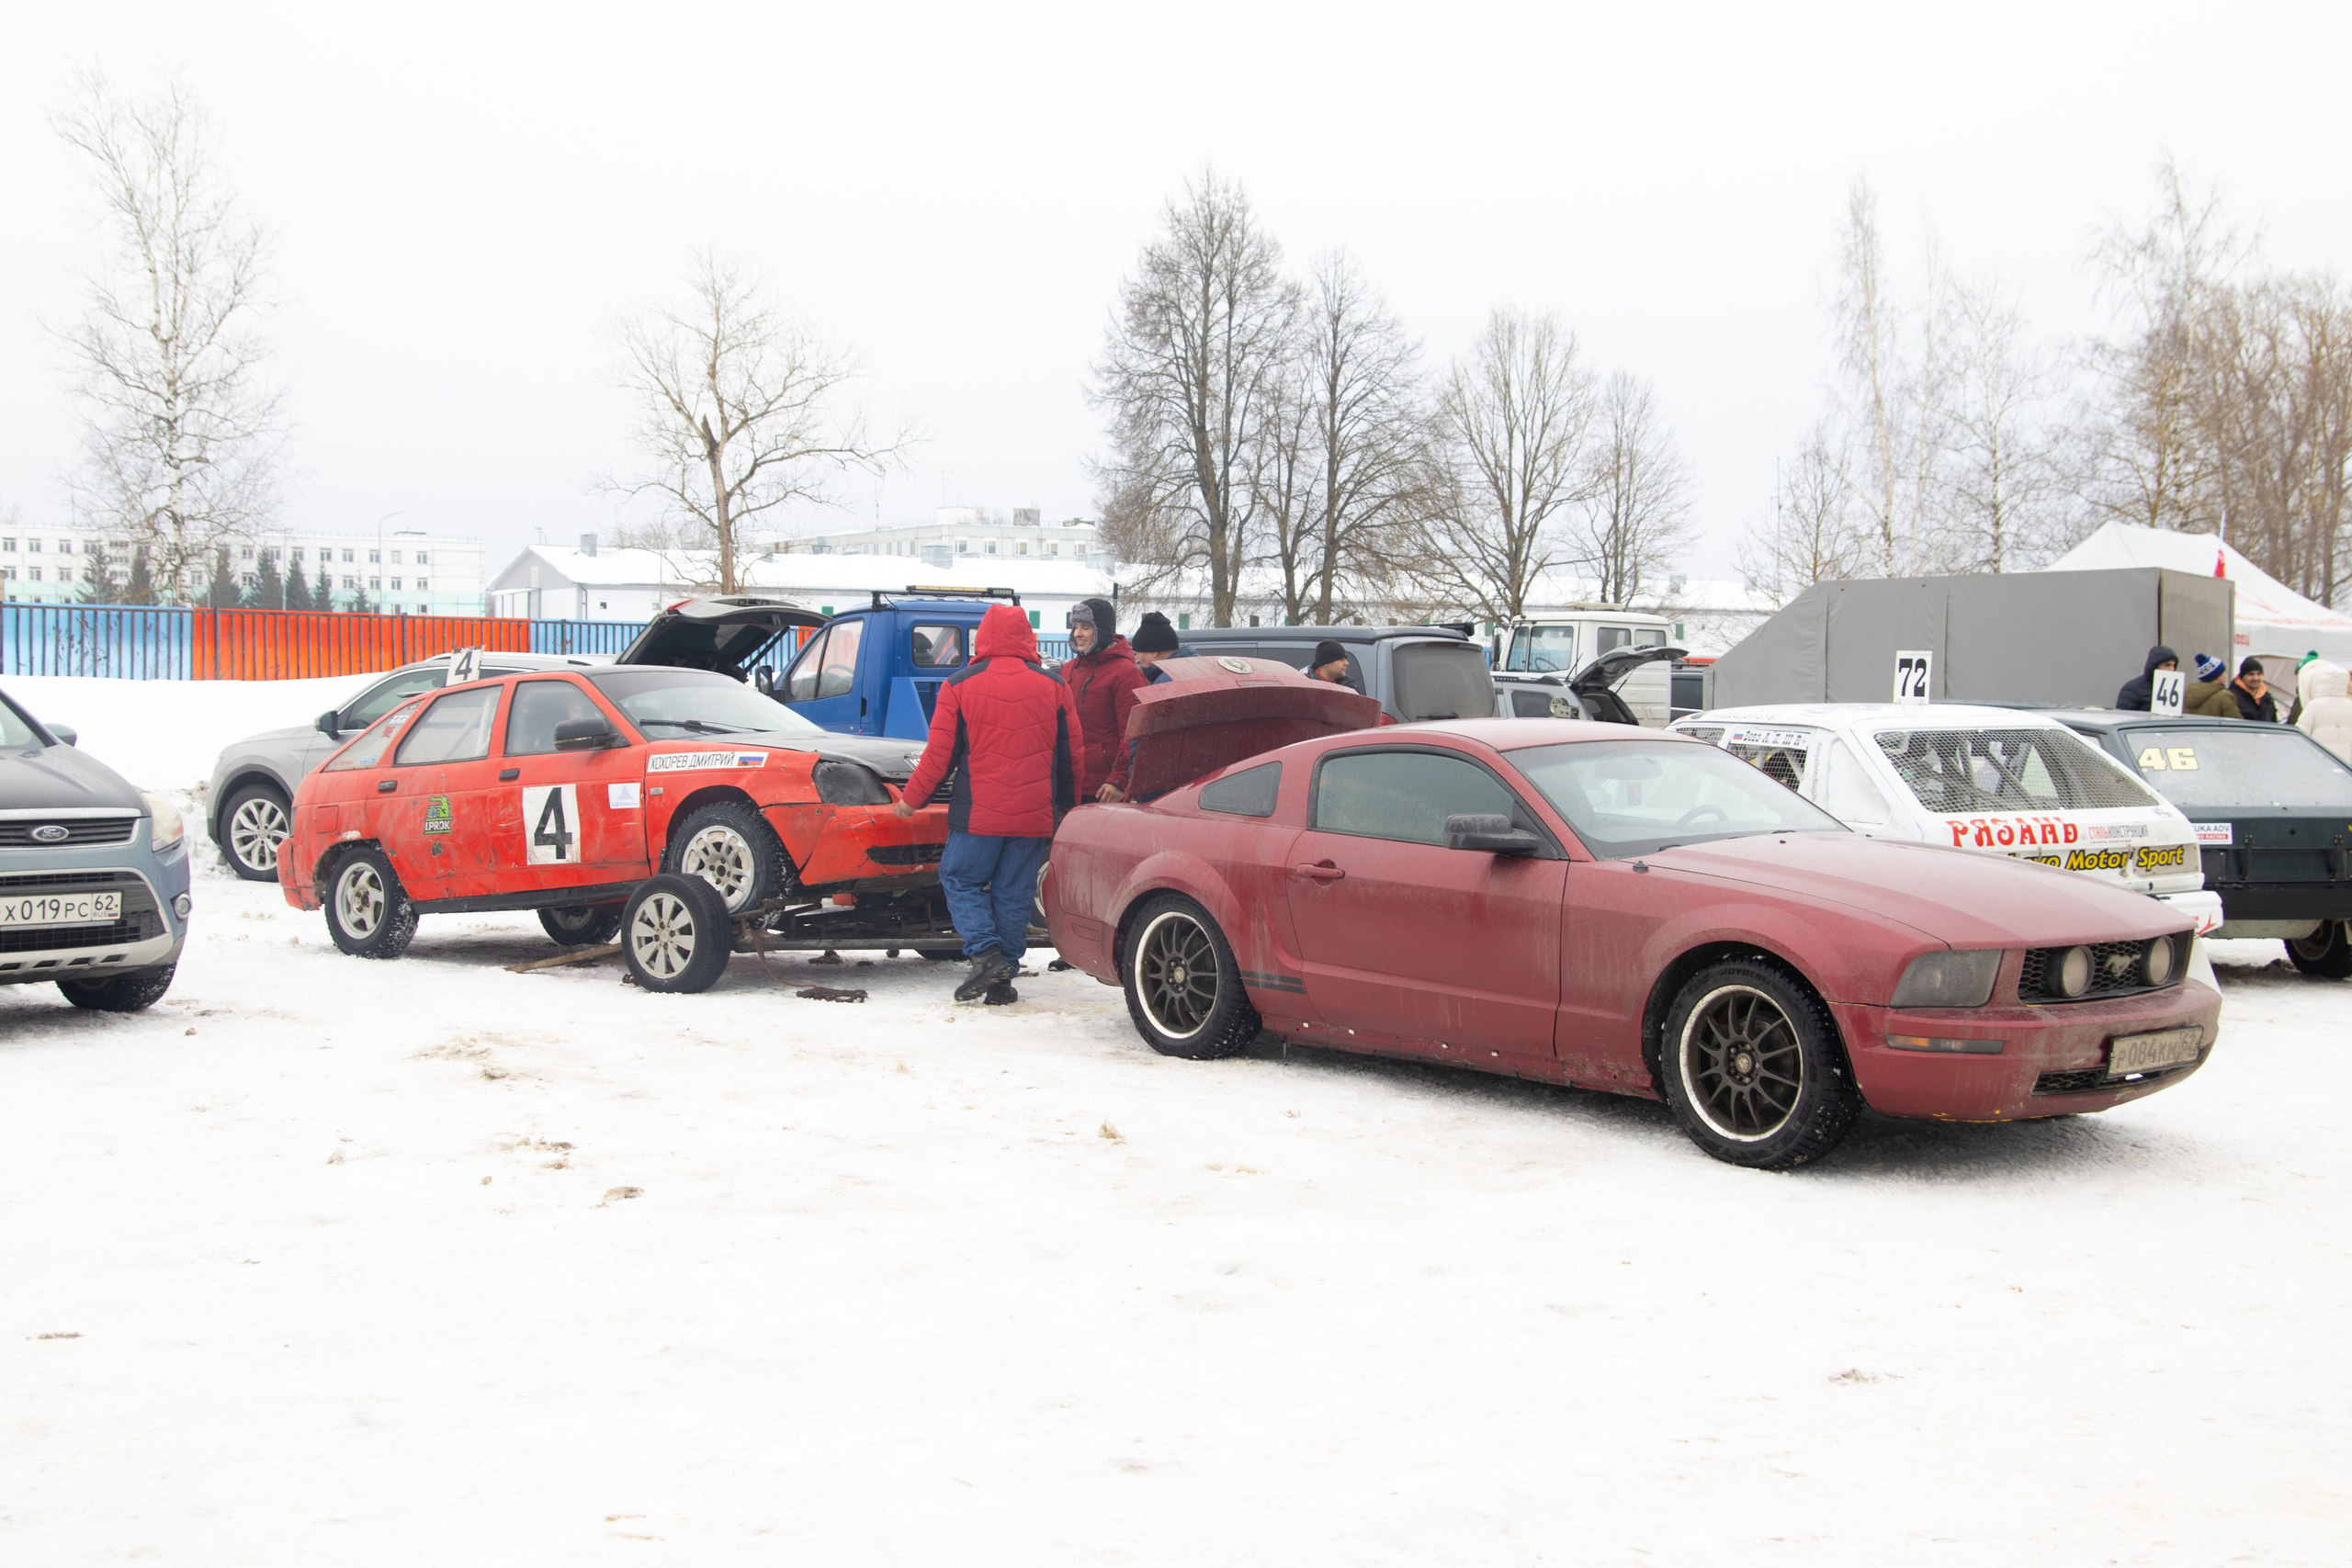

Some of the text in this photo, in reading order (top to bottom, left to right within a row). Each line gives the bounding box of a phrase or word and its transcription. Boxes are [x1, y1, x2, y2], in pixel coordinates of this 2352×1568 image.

[454, 650, 473, 682] 4
[1898, 658, 1928, 697] 72
[2156, 677, 2179, 707] 46
[650, 751, 736, 770] ХОХОРЕВ ДМИТРИЙ
[2137, 747, 2199, 771] 46
[41, 829, 62, 838] Ford
[424, 820, 451, 831] LPROK
[534, 787, 572, 860] 4
[1945, 817, 2079, 848] РЯЗАНЬ
[2137, 844, 2184, 872] Sport
[5, 898, 89, 921] Х019РС
[95, 895, 114, 911] 62
